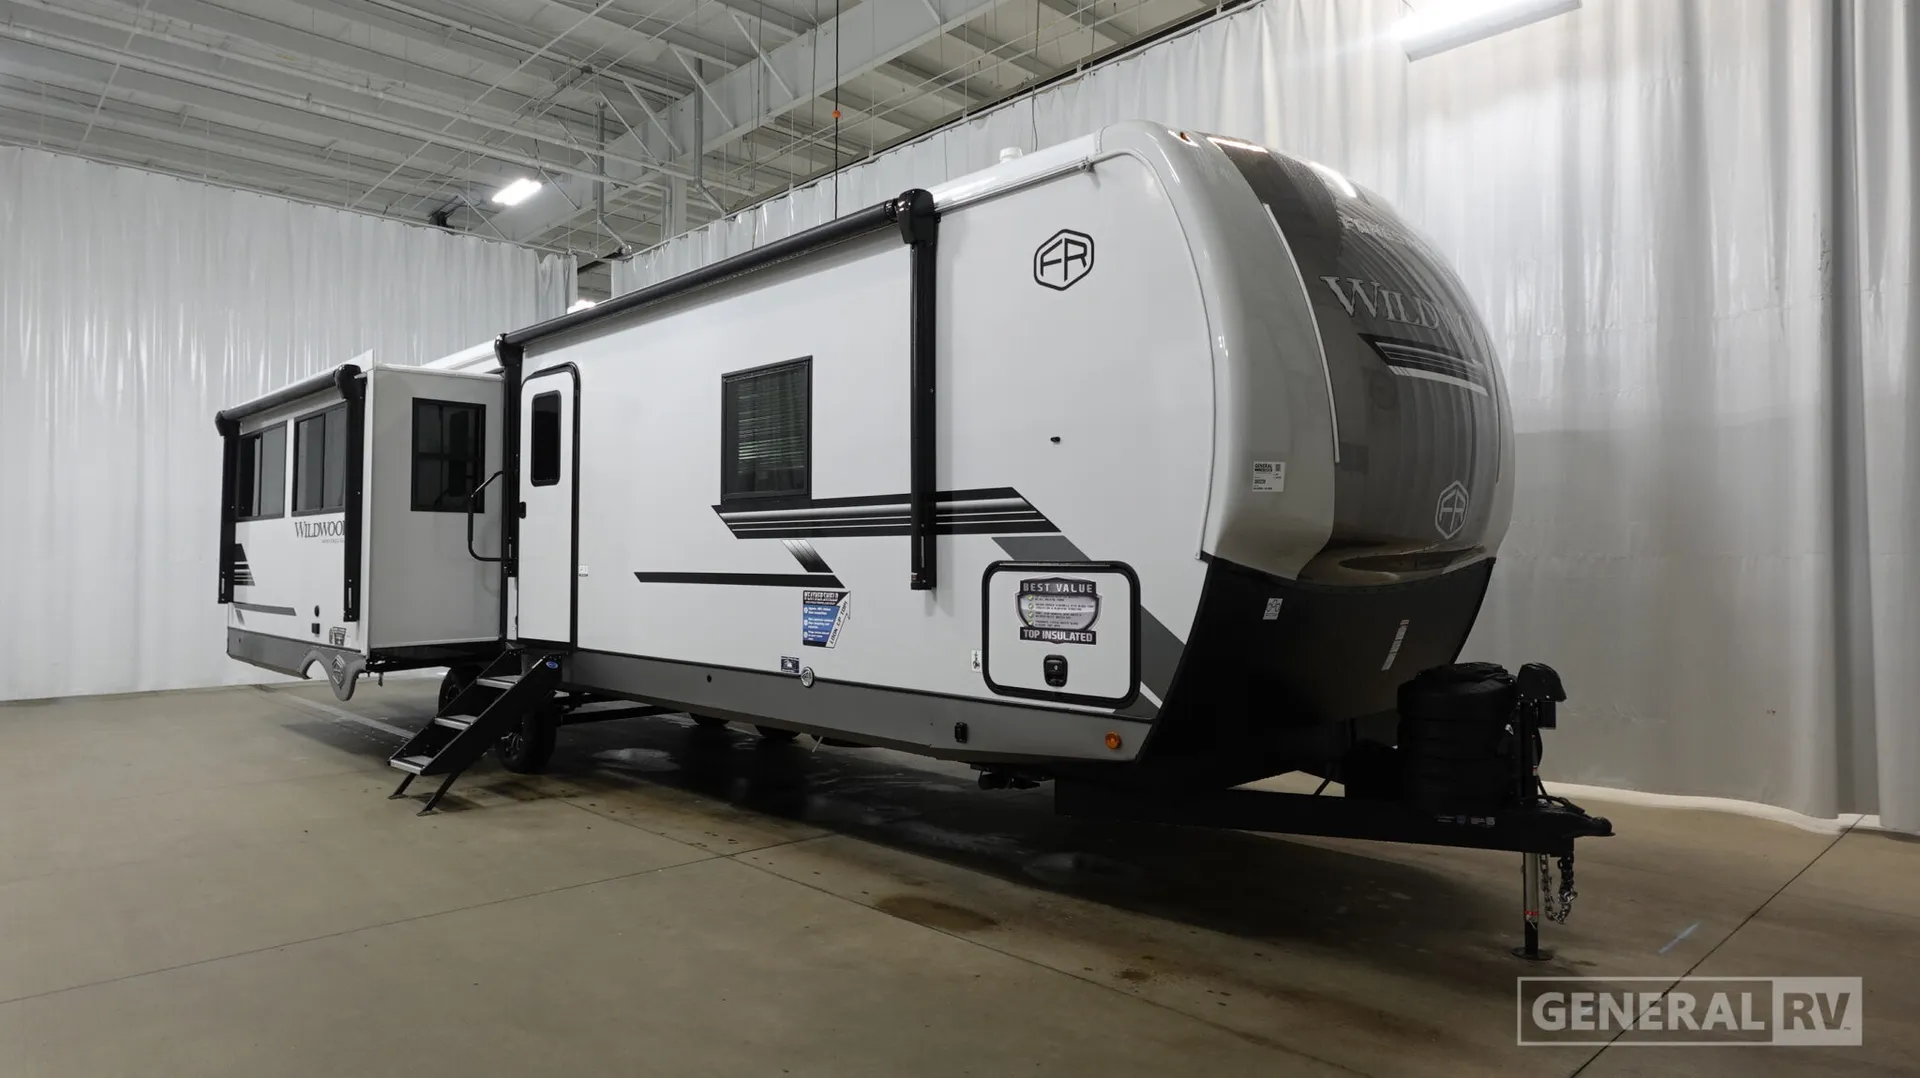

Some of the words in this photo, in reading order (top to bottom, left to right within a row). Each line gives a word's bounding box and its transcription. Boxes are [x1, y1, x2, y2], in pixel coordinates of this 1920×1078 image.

[1040, 236, 1088, 282] FR
[1023, 582, 1051, 592] BEST
[1056, 583, 1093, 593] VALUE
[1023, 629, 1041, 639] TOP
[1042, 630, 1093, 642] INSULATED
